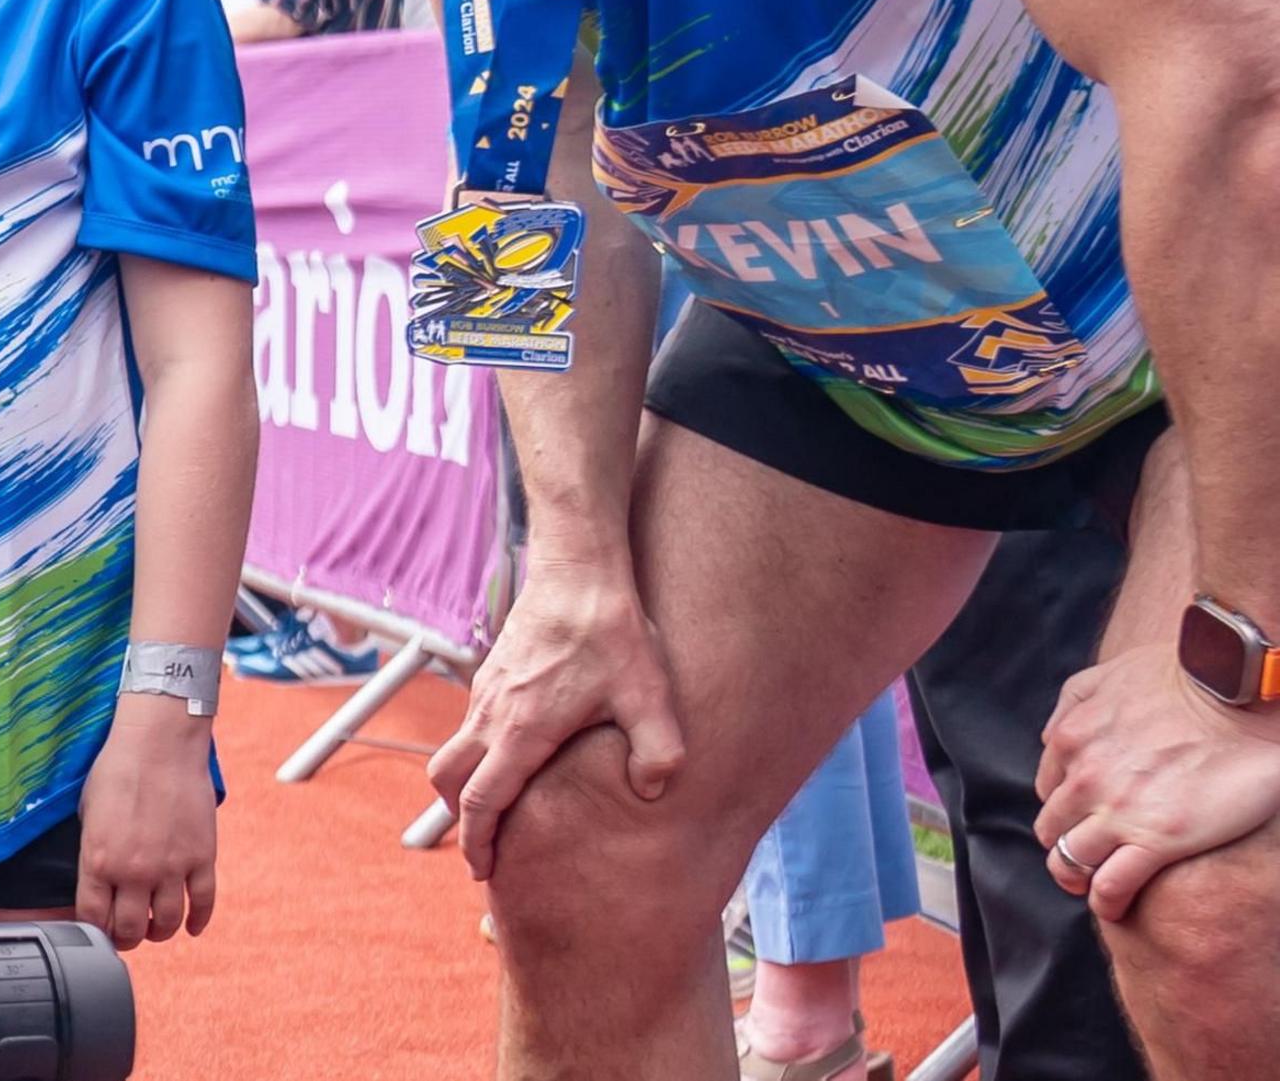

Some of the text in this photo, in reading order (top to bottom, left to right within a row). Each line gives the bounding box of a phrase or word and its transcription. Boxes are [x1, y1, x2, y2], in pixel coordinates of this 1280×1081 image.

[460, 1, 477, 56] Clarion
[507, 85, 537, 142] 2024
[703, 113, 819, 146] ROB BURROW
[142, 125, 243, 171] mn
[843, 119, 910, 153] Clarion
[505, 160, 521, 183] ALL
[521, 350, 568, 364] Clarion
[862, 363, 909, 383] ALL
[164, 662, 194, 679] VIP
